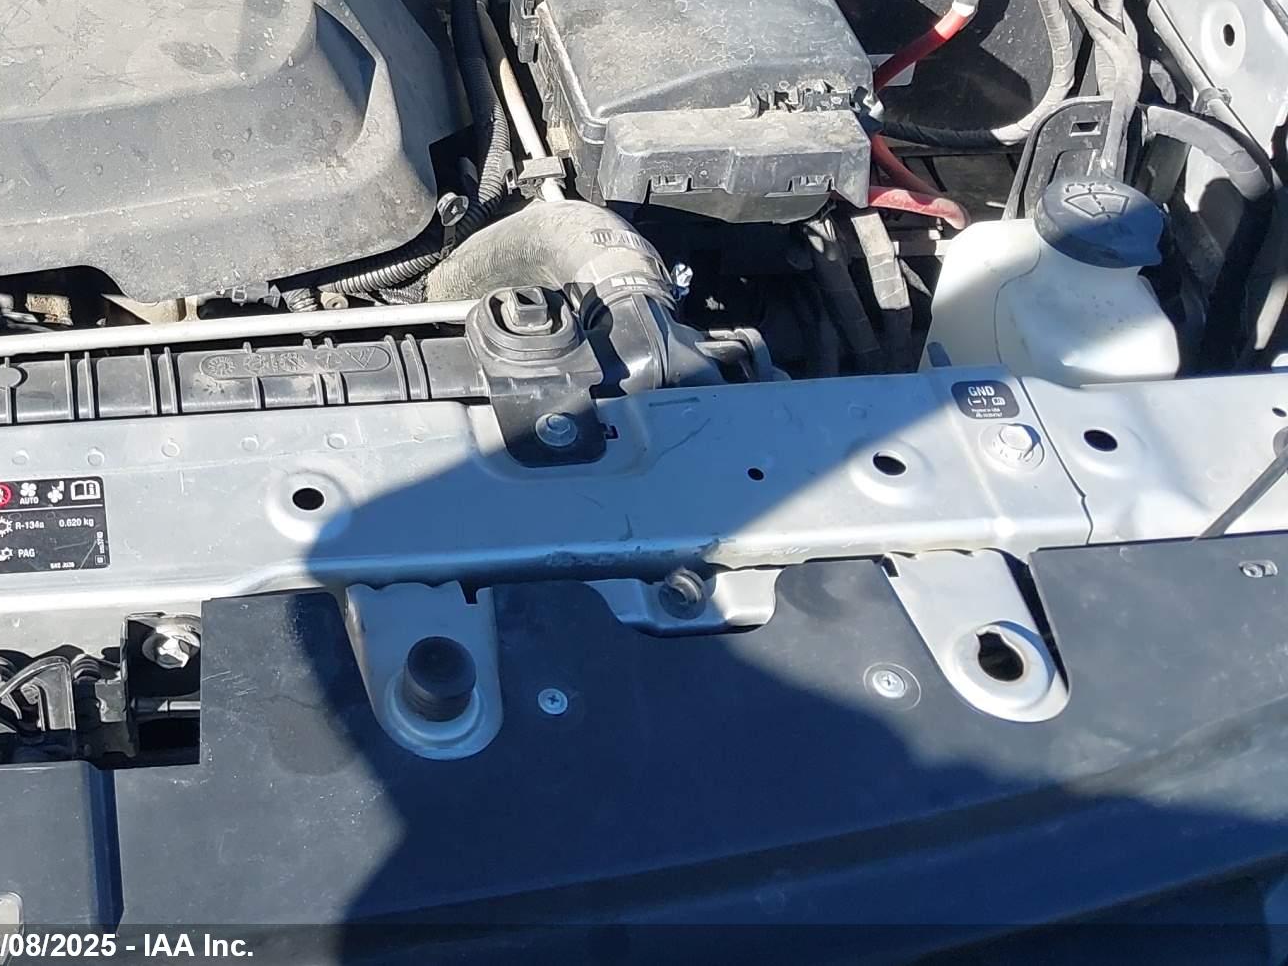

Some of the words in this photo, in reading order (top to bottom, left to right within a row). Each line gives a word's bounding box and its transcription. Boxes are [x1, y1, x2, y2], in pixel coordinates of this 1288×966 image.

[968, 385, 995, 397] GND
[19, 496, 39, 505] AUTO
[15, 520, 45, 530] R-134a
[83, 517, 95, 528] kg
[18, 548, 36, 558] PAG
